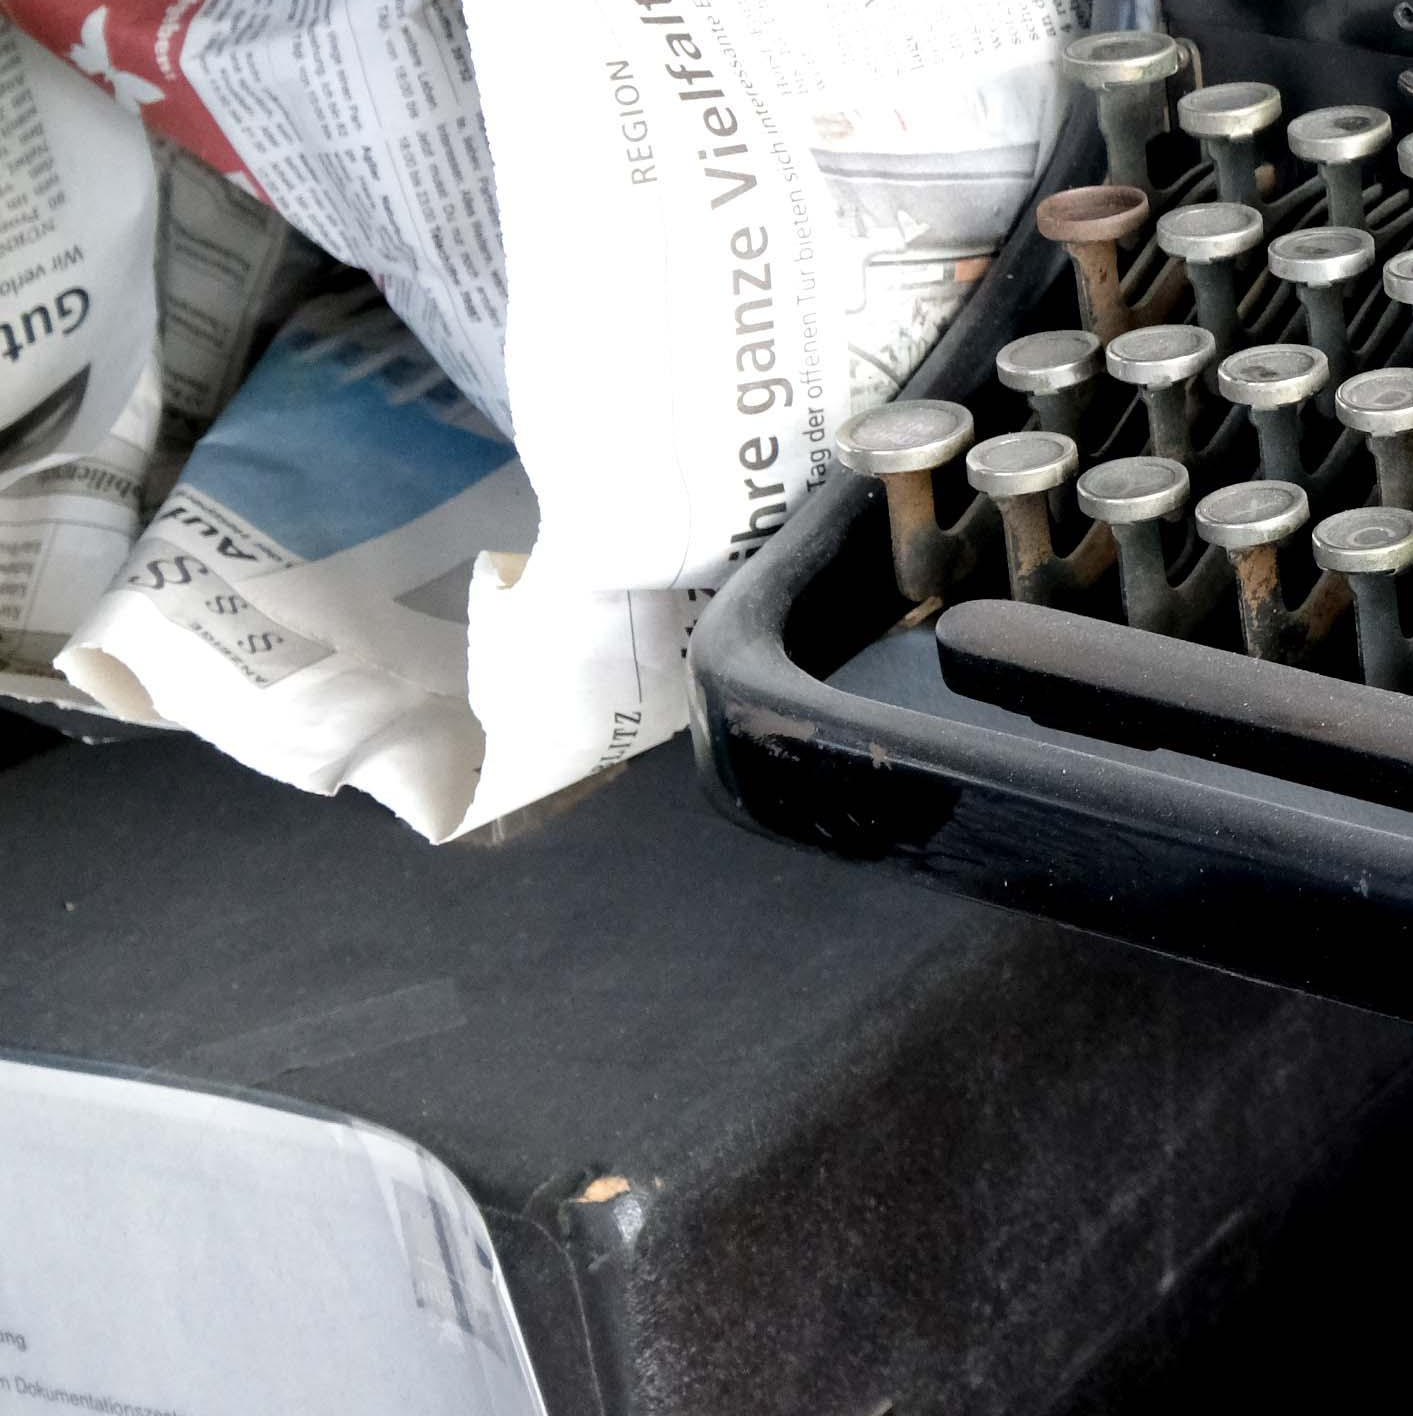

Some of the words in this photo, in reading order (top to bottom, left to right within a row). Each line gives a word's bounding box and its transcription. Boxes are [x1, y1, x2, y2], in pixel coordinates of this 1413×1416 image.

[708, 15, 778, 135] interessante
[604, 59, 658, 185] REGION
[769, 141, 799, 183] sich
[52, 244, 84, 271] Wir
[790, 189, 814, 263] bieten
[0, 287, 90, 363] Gut
[730, 225, 793, 417] ganze
[800, 311, 824, 399] offenen
[801, 407, 826, 442] der
[806, 447, 832, 491] Tag
